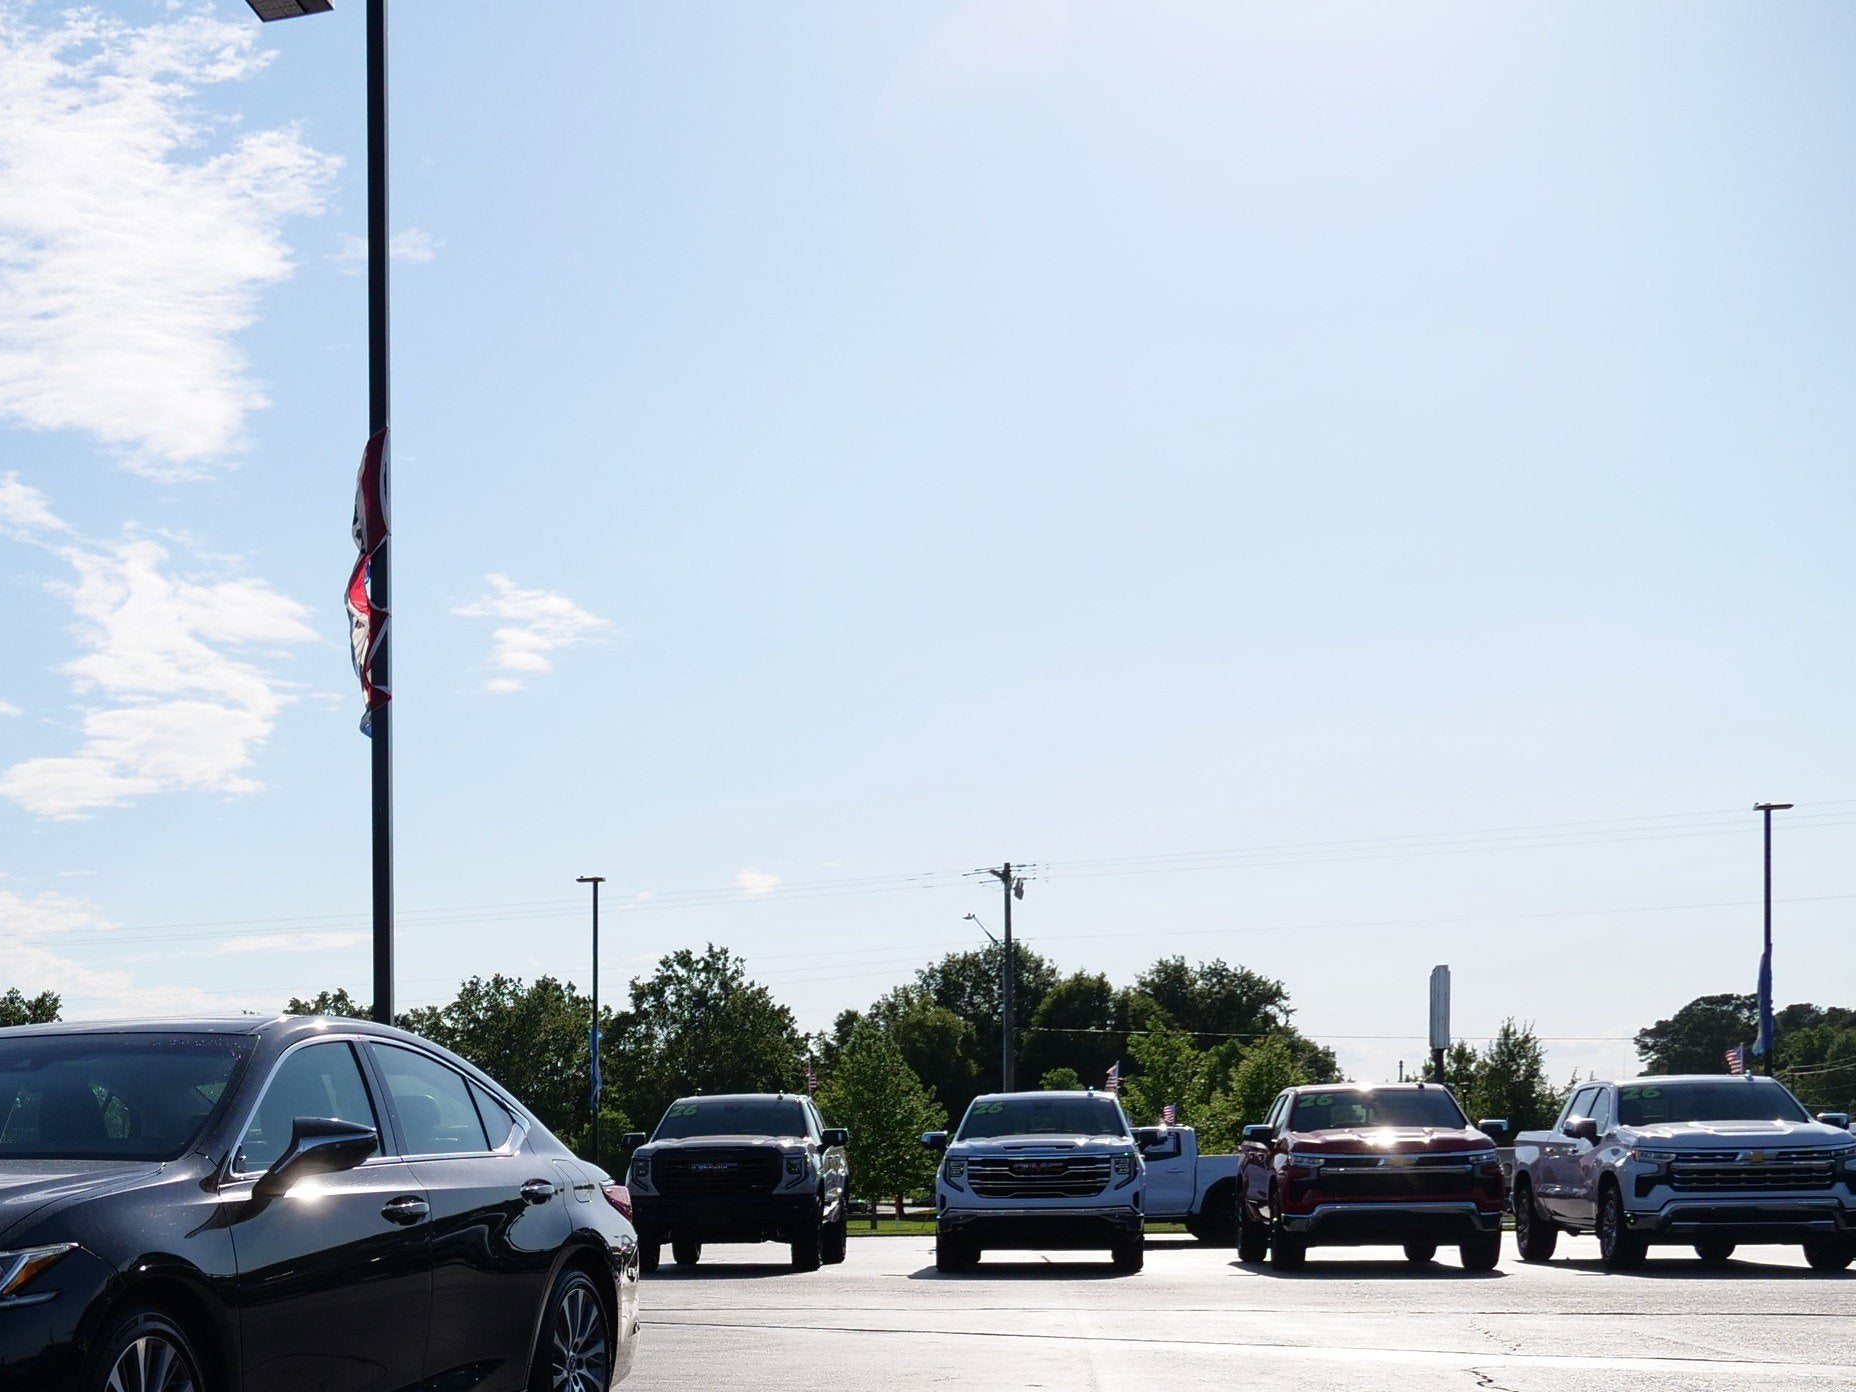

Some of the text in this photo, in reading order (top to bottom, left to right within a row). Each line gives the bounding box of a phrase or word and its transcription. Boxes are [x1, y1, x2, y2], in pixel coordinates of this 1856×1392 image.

[1622, 1085, 1661, 1100] 26
[972, 1101, 1004, 1115] 26
[1299, 1094, 1334, 1108] 26
[667, 1104, 698, 1118] 26
